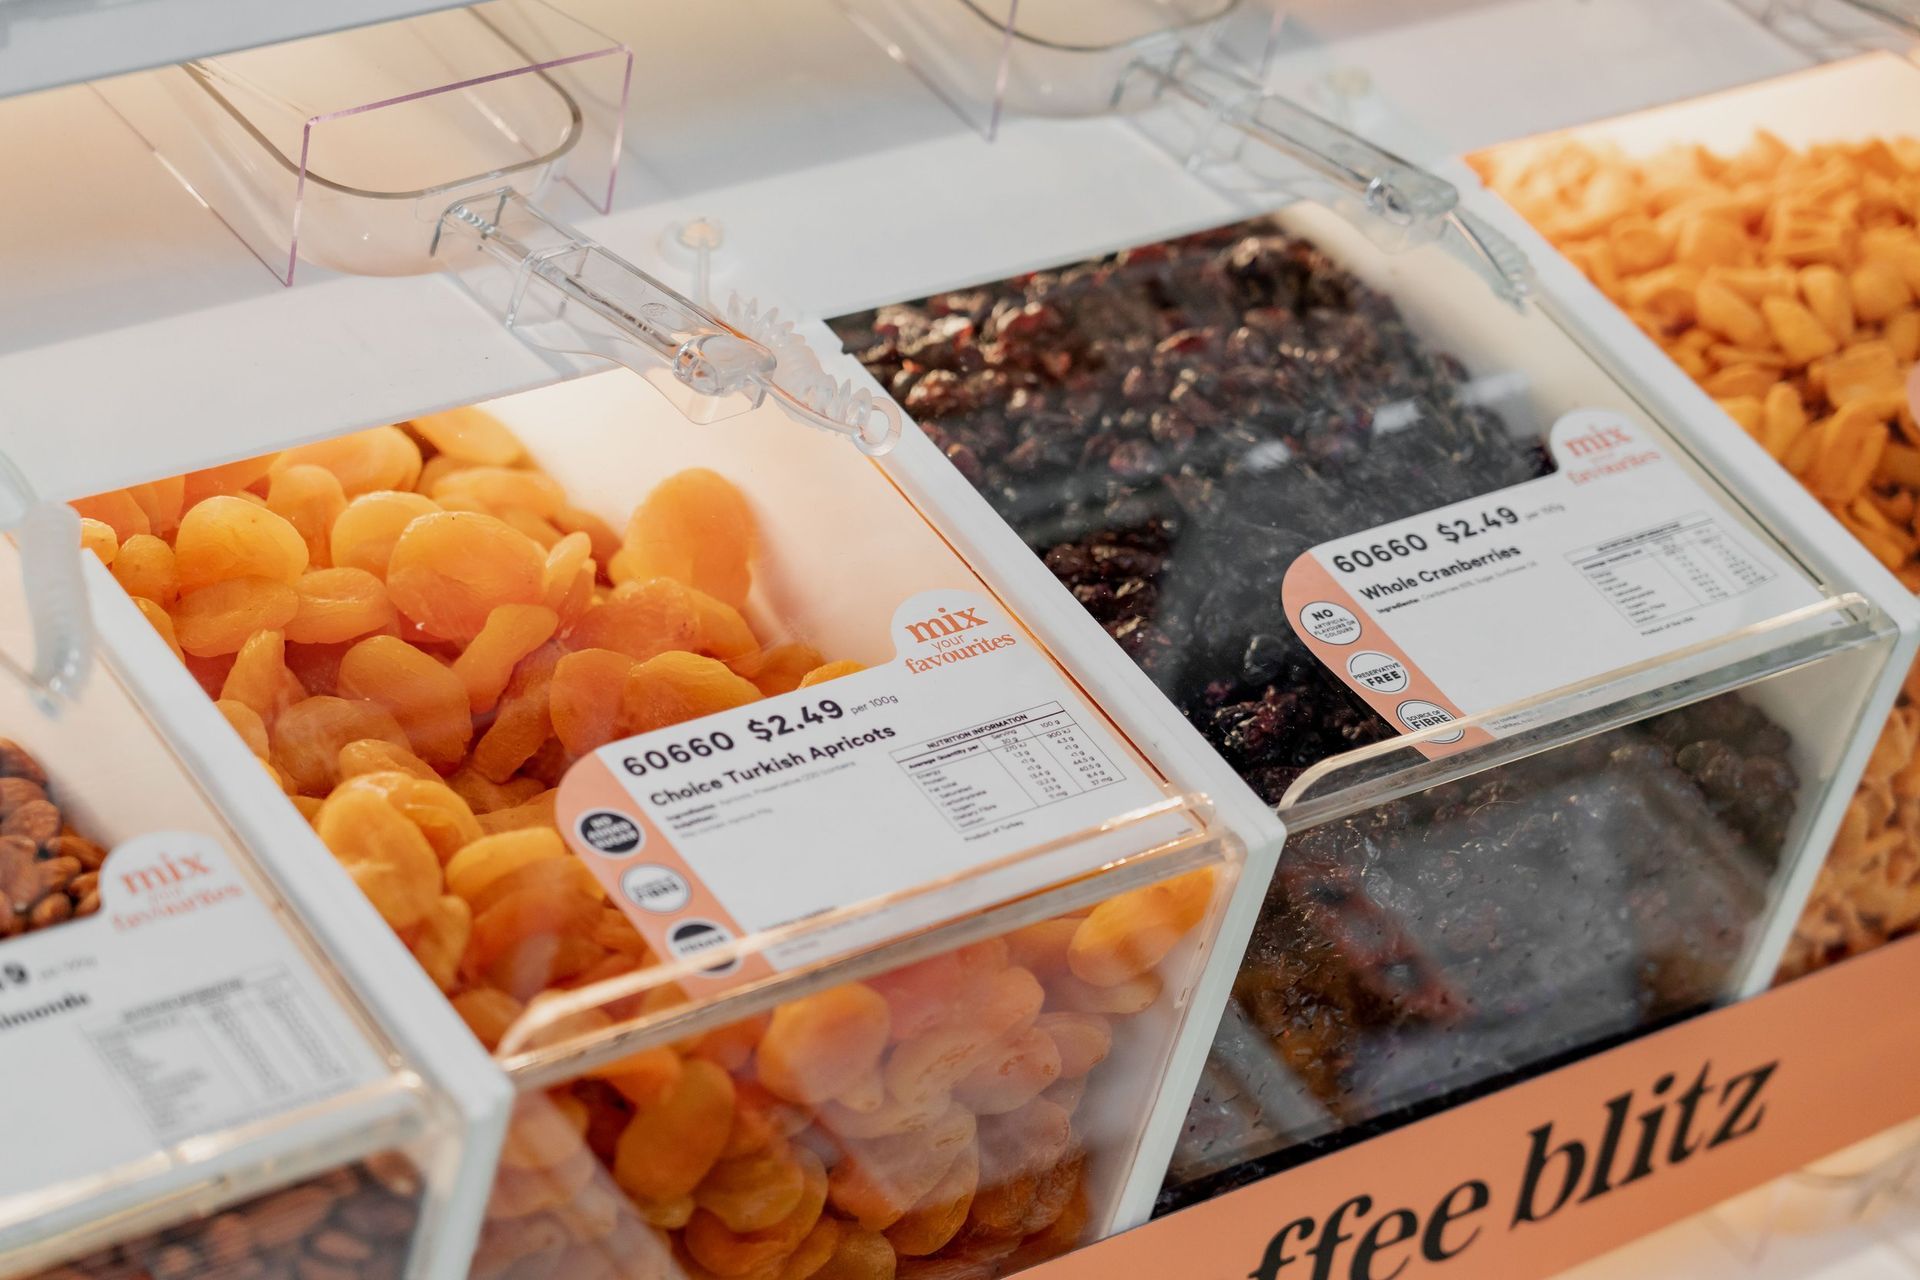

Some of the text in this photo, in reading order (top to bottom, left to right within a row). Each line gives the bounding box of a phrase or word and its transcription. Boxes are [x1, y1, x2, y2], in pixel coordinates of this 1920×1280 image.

[1564, 423, 1634, 457] mix
[1333, 534, 1428, 573] 60660
[1437, 507, 1519, 544] $2.49
[1360, 545, 1521, 600] Whole Cranberries
[1312, 610, 1333, 620] NO
[1314, 618, 1348, 629] ARTIFICIAL
[905, 607, 988, 643] mix
[1314, 624, 1345, 635] FLAVOURS
[1325, 628, 1354, 638] COLOURS
[931, 635, 965, 653] your
[905, 634, 1016, 674] favourites
[1354, 662, 1401, 679] PRESERVATIVE
[1366, 671, 1401, 686] FREE
[1040, 719, 1061, 729] 100 g
[1407, 713, 1428, 721] SOURCE
[1411, 715, 1450, 729] FIBRE
[623, 695, 898, 776] 60660 $2.49 per 100g
[927, 714, 1027, 749] NUTRITION INFORMATION
[991, 729, 1017, 740] Serving
[1047, 731, 1059, 740] 900
[650, 725, 896, 806] Choice Turkish Apricots
[120, 851, 213, 896] mix
[0, 990, 91, 1032] lmonds
[1509, 1058, 1781, 1233] blitz
